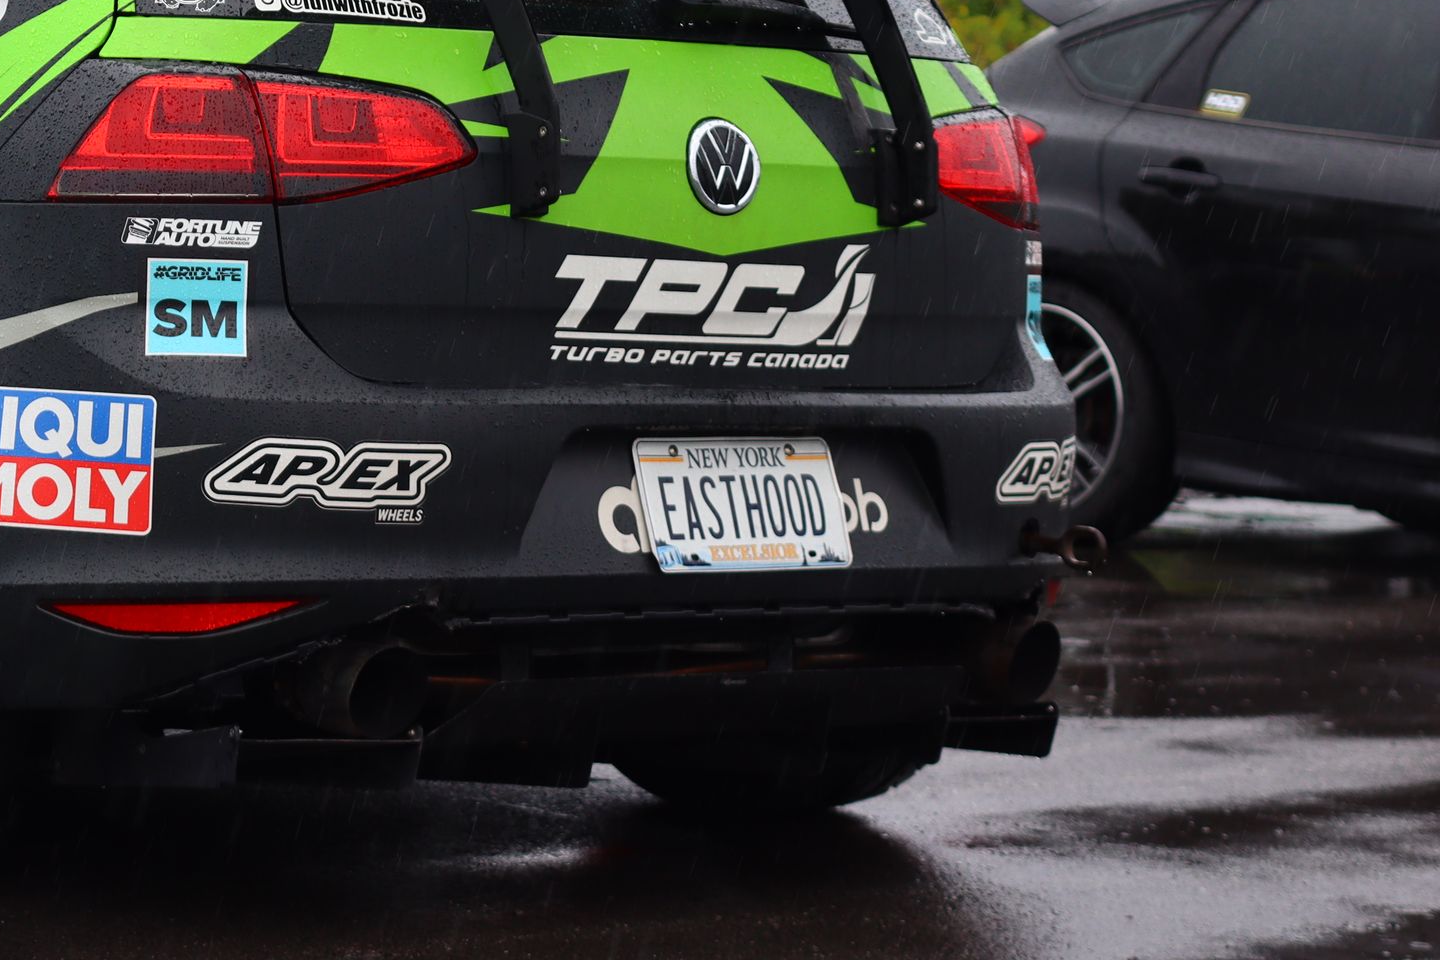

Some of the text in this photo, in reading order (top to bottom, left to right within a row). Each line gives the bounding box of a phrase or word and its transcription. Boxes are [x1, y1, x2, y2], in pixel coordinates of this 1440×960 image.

[158, 218, 262, 235] FORTUNE
[154, 232, 217, 247] AUTO
[153, 265, 242, 282] #GRIDLIFE
[554, 254, 806, 336] TPC
[153, 298, 238, 338] SM
[685, 447, 785, 469] NEW YORK
[222, 450, 434, 495] APEX
[377, 508, 424, 522] WHEELS
[658, 473, 827, 541] EASTHOOD
[708, 543, 800, 562] EXCELSIOR
